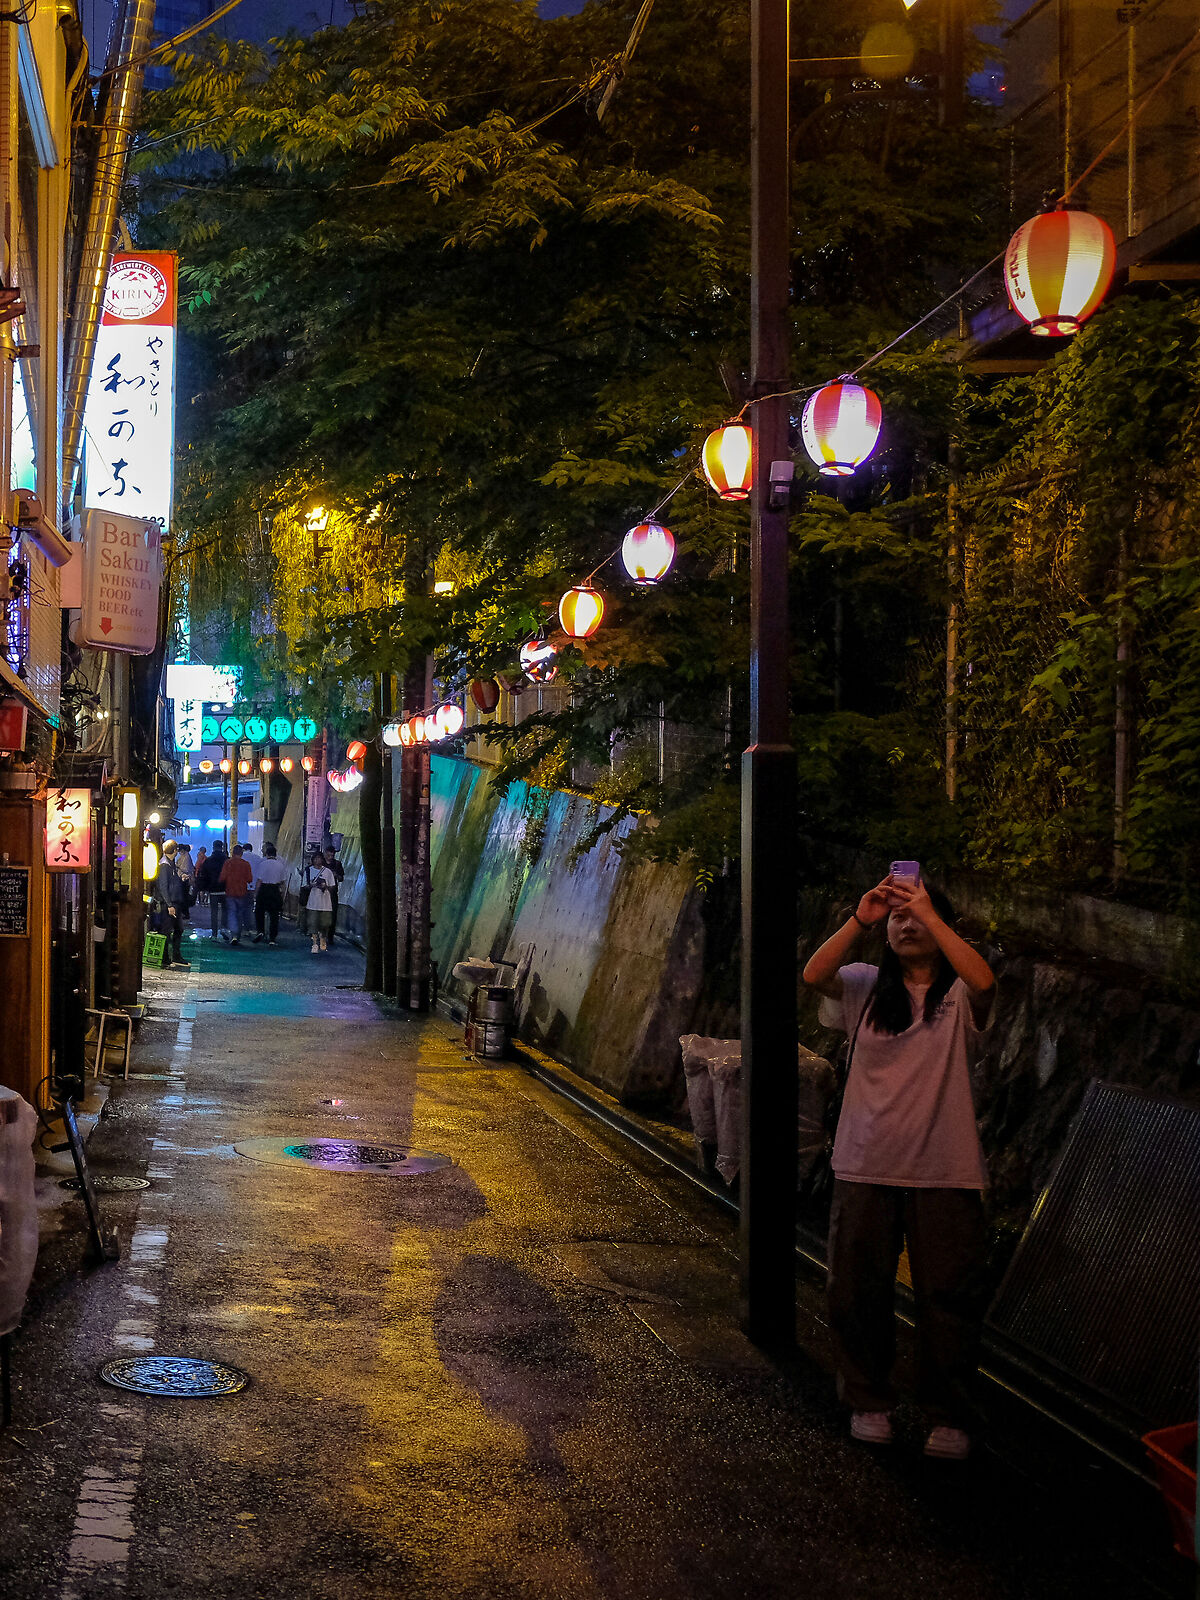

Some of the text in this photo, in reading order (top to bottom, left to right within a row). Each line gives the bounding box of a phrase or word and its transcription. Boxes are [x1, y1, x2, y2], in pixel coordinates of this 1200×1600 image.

[112, 290, 152, 299] KIRIN
[146, 336, 163, 417] やきとり
[102, 521, 141, 549] Bar
[99, 587, 132, 602] FOOD
[98, 601, 144, 617] BEER etc
